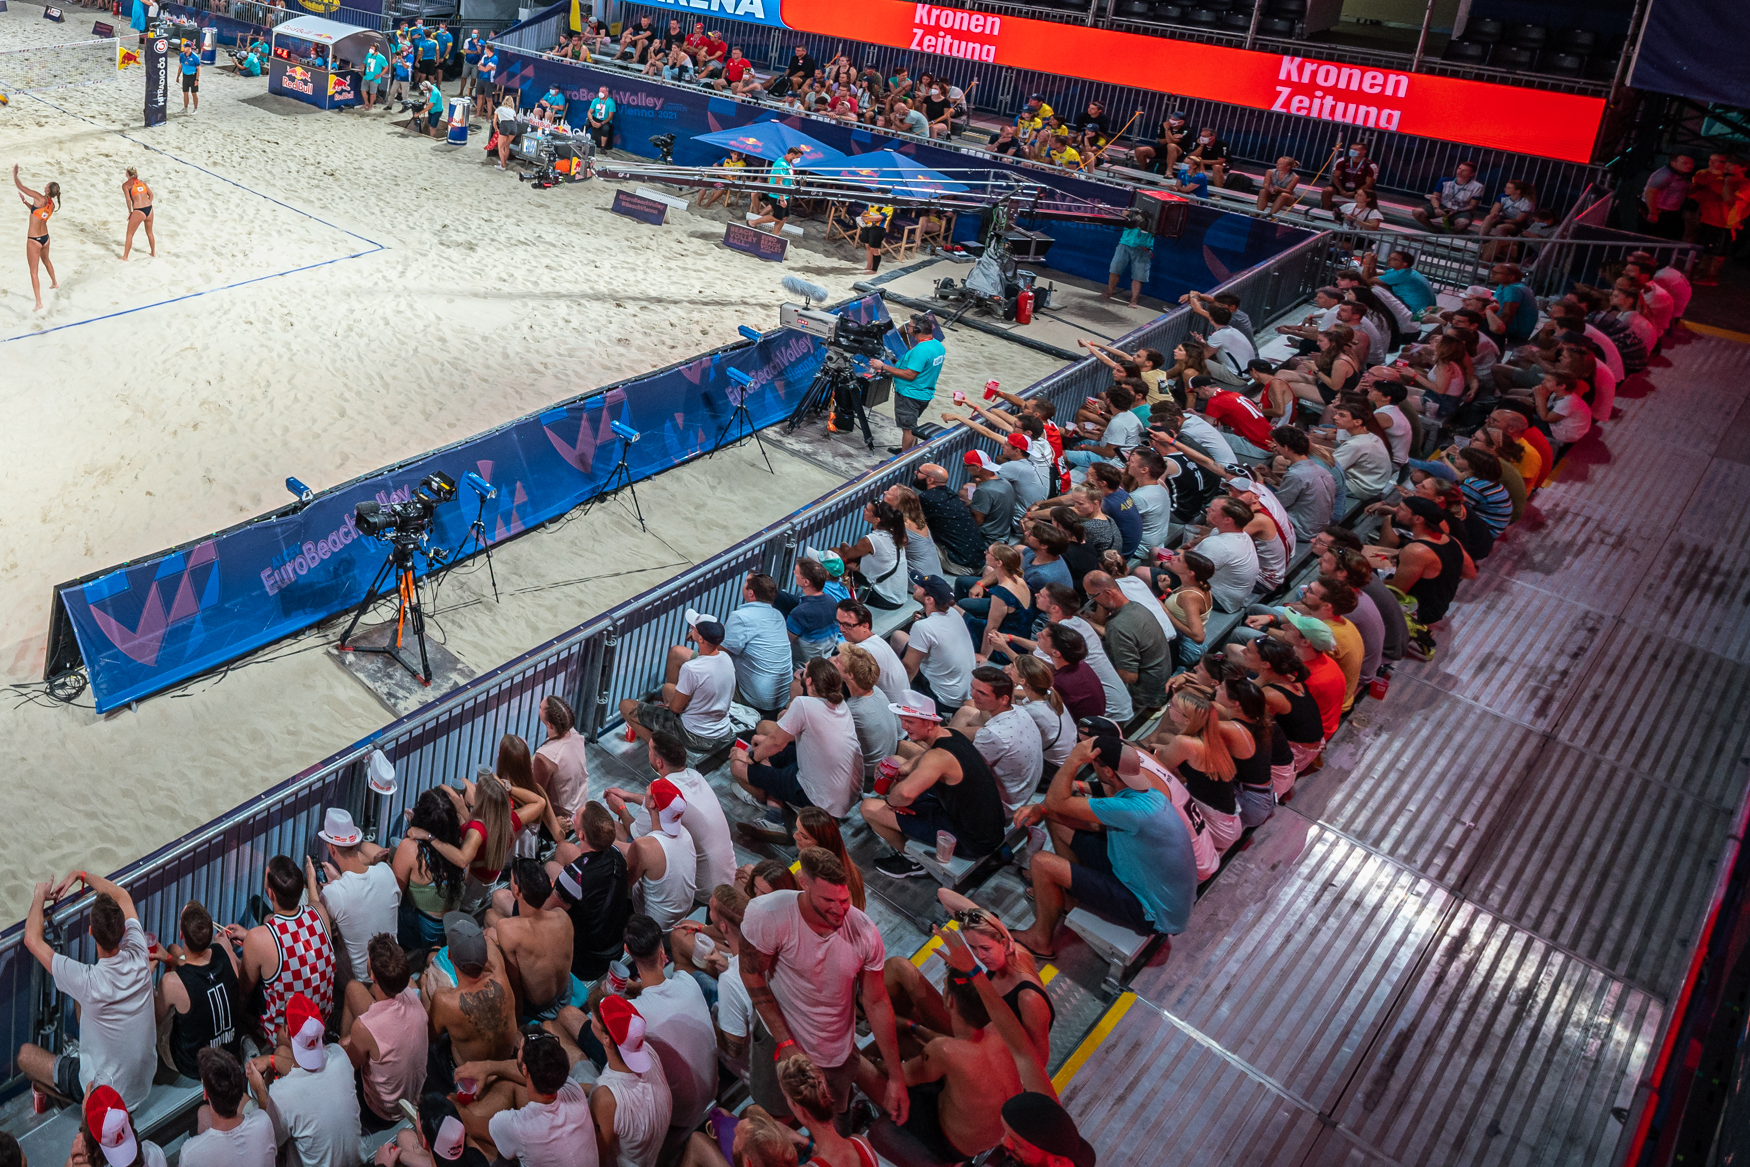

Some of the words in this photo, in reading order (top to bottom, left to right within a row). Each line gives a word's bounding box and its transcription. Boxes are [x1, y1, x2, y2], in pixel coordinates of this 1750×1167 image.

[913, 2, 1001, 36] Kronen
[909, 27, 997, 63] Zeitung
[157, 71, 166, 107] HITRADIO
[282, 75, 298, 91] Red
[297, 80, 314, 96] Bull
[1278, 54, 1410, 99] Kronen
[616, 104, 655, 119] Vienna
[657, 110, 678, 120] 2021
[1270, 85, 1402, 132] Zeitung
